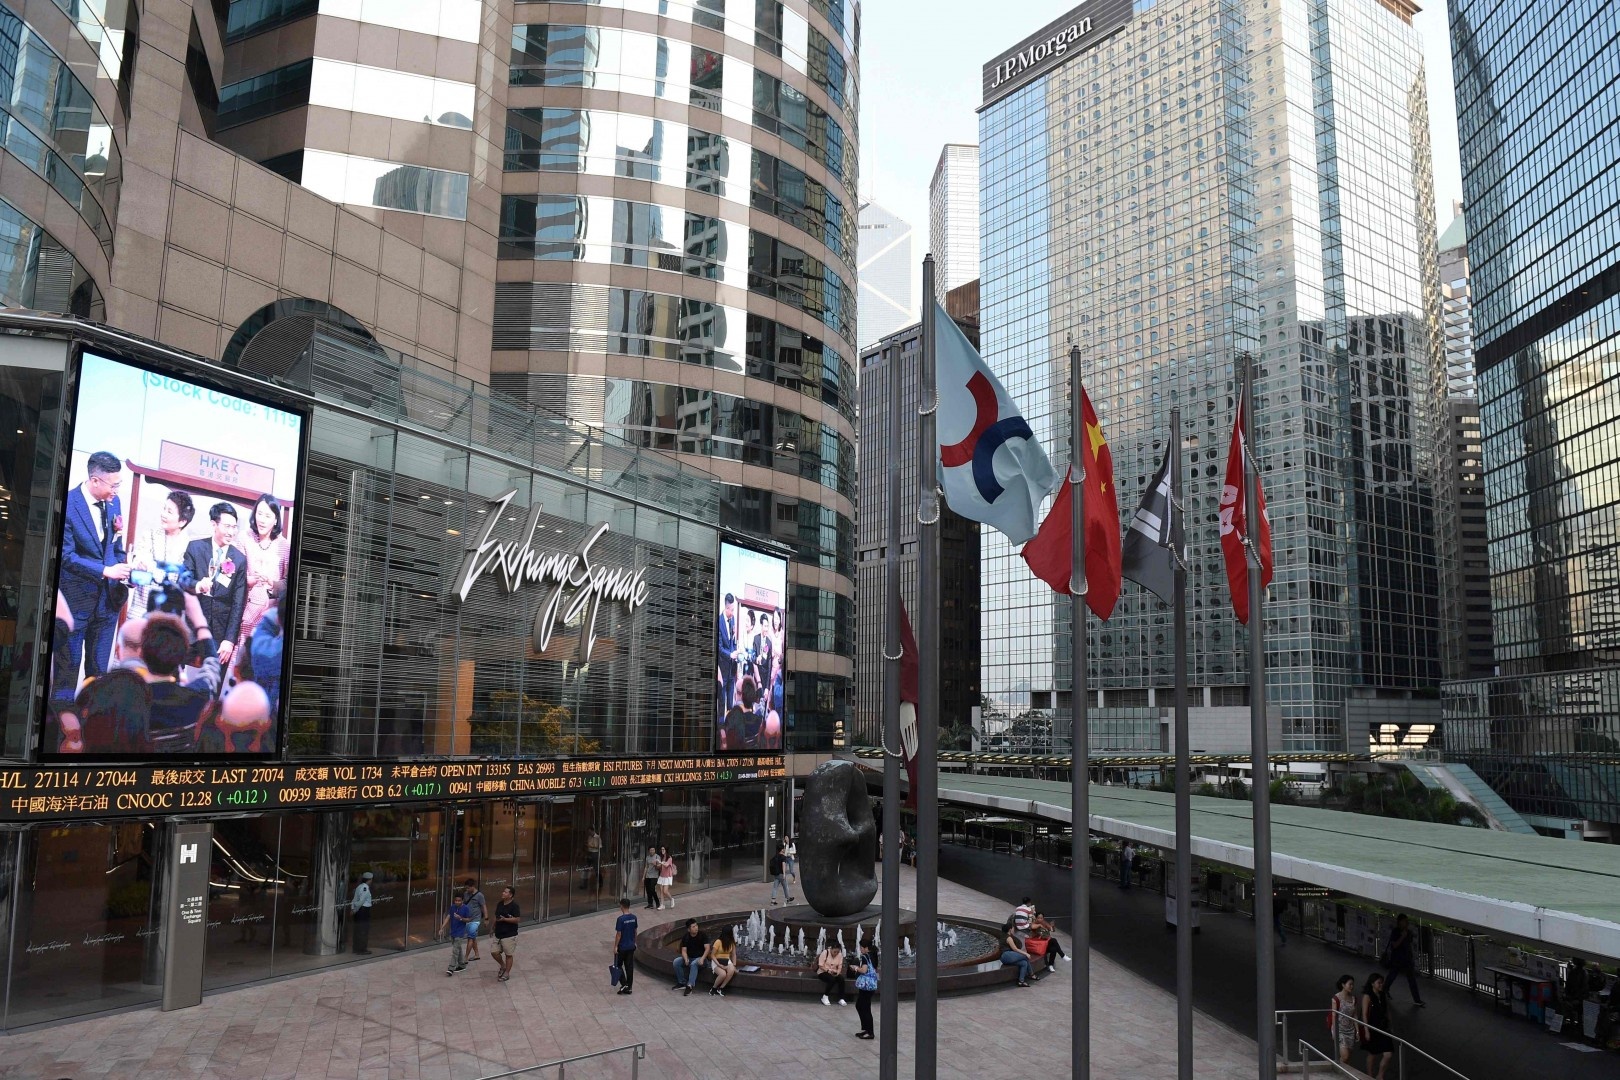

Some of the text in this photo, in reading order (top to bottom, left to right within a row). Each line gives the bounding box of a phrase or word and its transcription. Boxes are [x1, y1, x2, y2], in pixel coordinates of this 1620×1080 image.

[142, 370, 301, 432] (Stock Code: 1119
[457, 486, 650, 662] Exchange Square
[11, 794, 109, 814] 中國海洋石油
[117, 792, 173, 810] CNOOC
[180, 791, 212, 808] 12.28
[279, 787, 311, 803] 00939
[315, 786, 358, 801] 建設銀行
[361, 785, 384, 799] CCB
[387, 784, 402, 798] 6.2
[449, 781, 472, 795] 00941
[476, 780, 507, 793] 中國移動
[509, 779, 536, 792] CHINA
[536, 777, 566, 790] MOBILE
[568, 777, 582, 788] 67.3
[674, 771, 702, 783] HOLDINGS
[34, 772, 79, 788] 27114
[95, 770, 137, 787] 27044
[150, 769, 206, 785] 最後成交
[211, 768, 247, 784] LAST
[251, 768, 285, 782] 27074
[294, 767, 330, 781] 成交額
[333, 766, 357, 780] VOL
[361, 766, 383, 780] 1734
[390, 765, 437, 779] 未平倉合約
[440, 764, 466, 777] OPEN
[466, 764, 483, 776] INT
[486, 763, 511, 776] 133155
[517, 763, 534, 775] EAS
[535, 762, 556, 774] 26993
[603, 761, 615, 772] HSI
[615, 760, 643, 771] FUTURES
[645, 760, 656, 770] 下月
[657, 760, 674, 769] NEXT
[673, 759, 694, 769] MONTH
[180, 843, 198, 864] H
